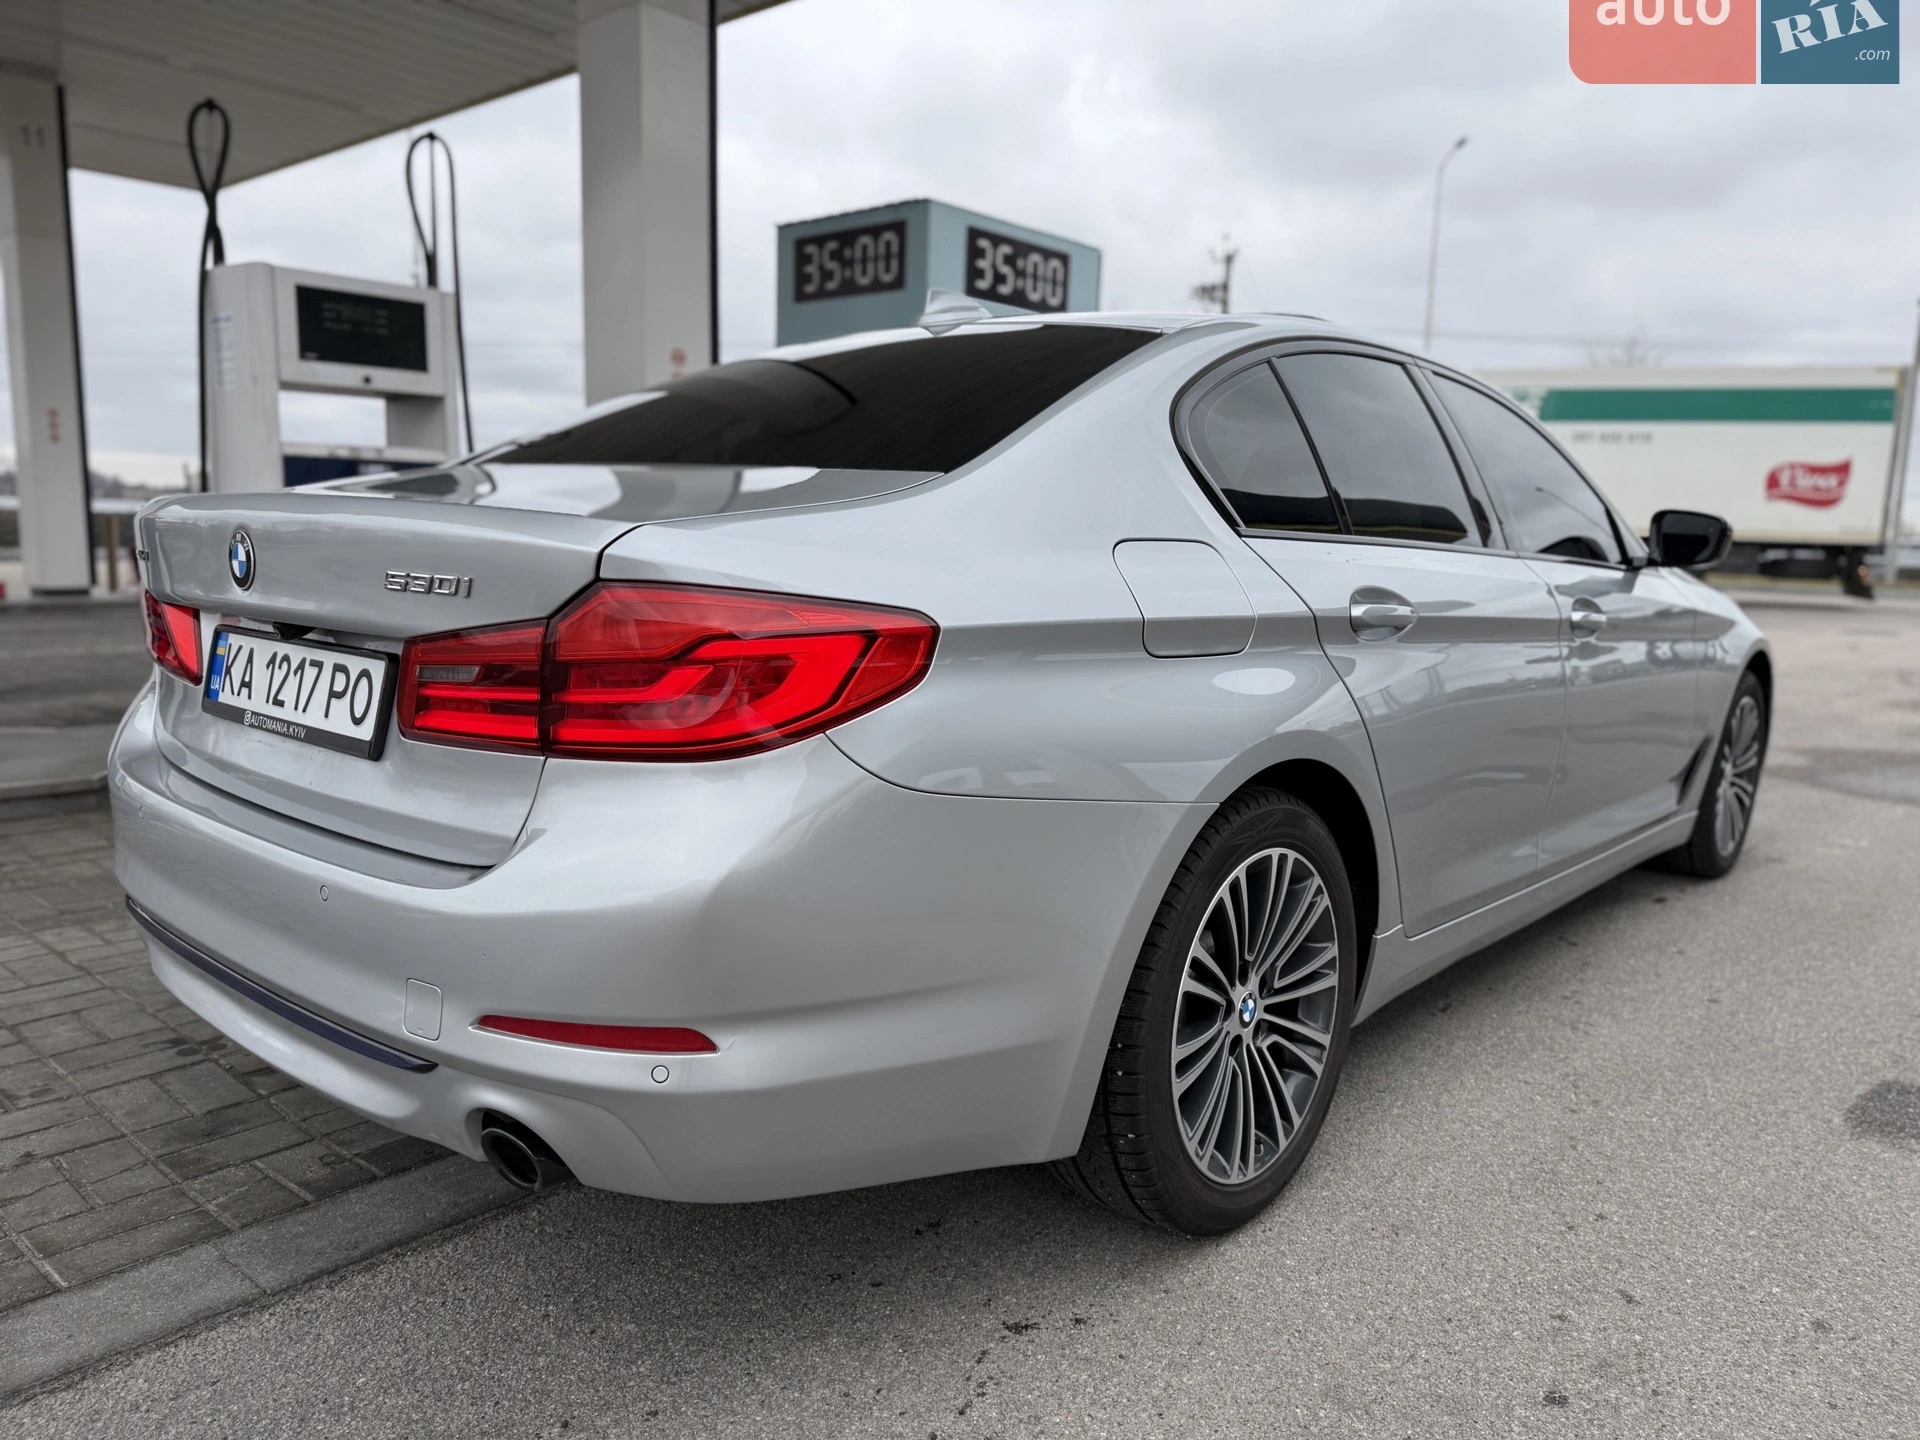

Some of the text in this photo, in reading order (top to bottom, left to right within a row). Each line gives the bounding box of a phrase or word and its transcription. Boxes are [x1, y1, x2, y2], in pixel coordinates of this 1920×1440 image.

[803, 230, 900, 295] 35:00
[973, 237, 1066, 308] 35:00
[384, 570, 473, 598] 530i
[210, 674, 220, 691] UA
[221, 642, 374, 726] KA 1217 PO
